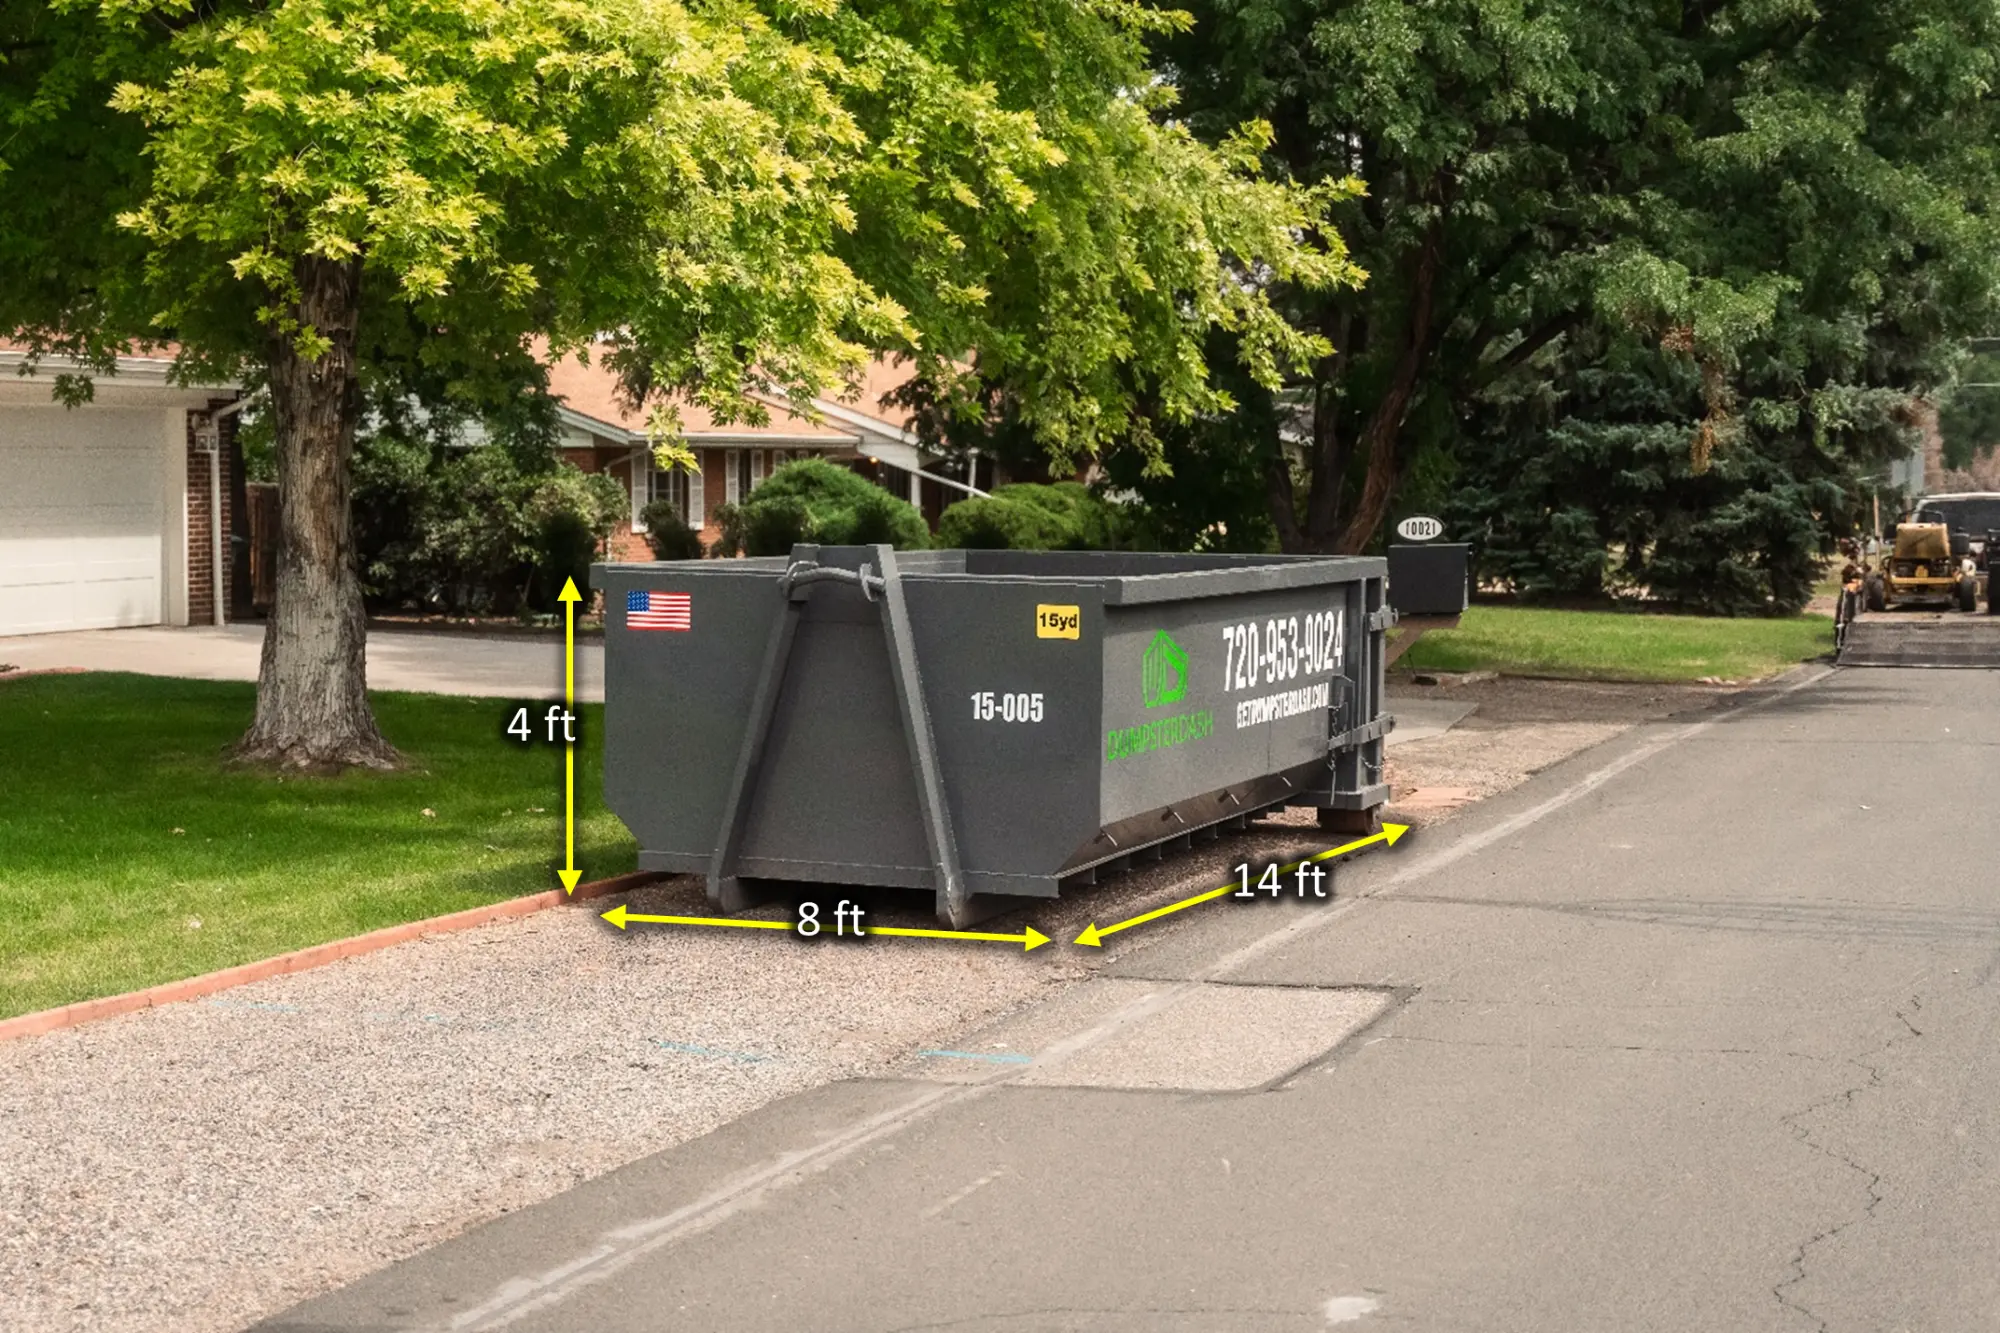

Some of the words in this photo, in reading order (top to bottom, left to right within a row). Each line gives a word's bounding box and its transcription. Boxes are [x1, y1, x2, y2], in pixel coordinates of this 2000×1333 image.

[1406, 521, 1436, 536] 10021
[1039, 612, 1078, 632] 15yd
[1223, 610, 1344, 692] 720-953-9024
[970, 692, 1044, 723] 15-005
[1106, 709, 1214, 762] DUMPSTERDASH
